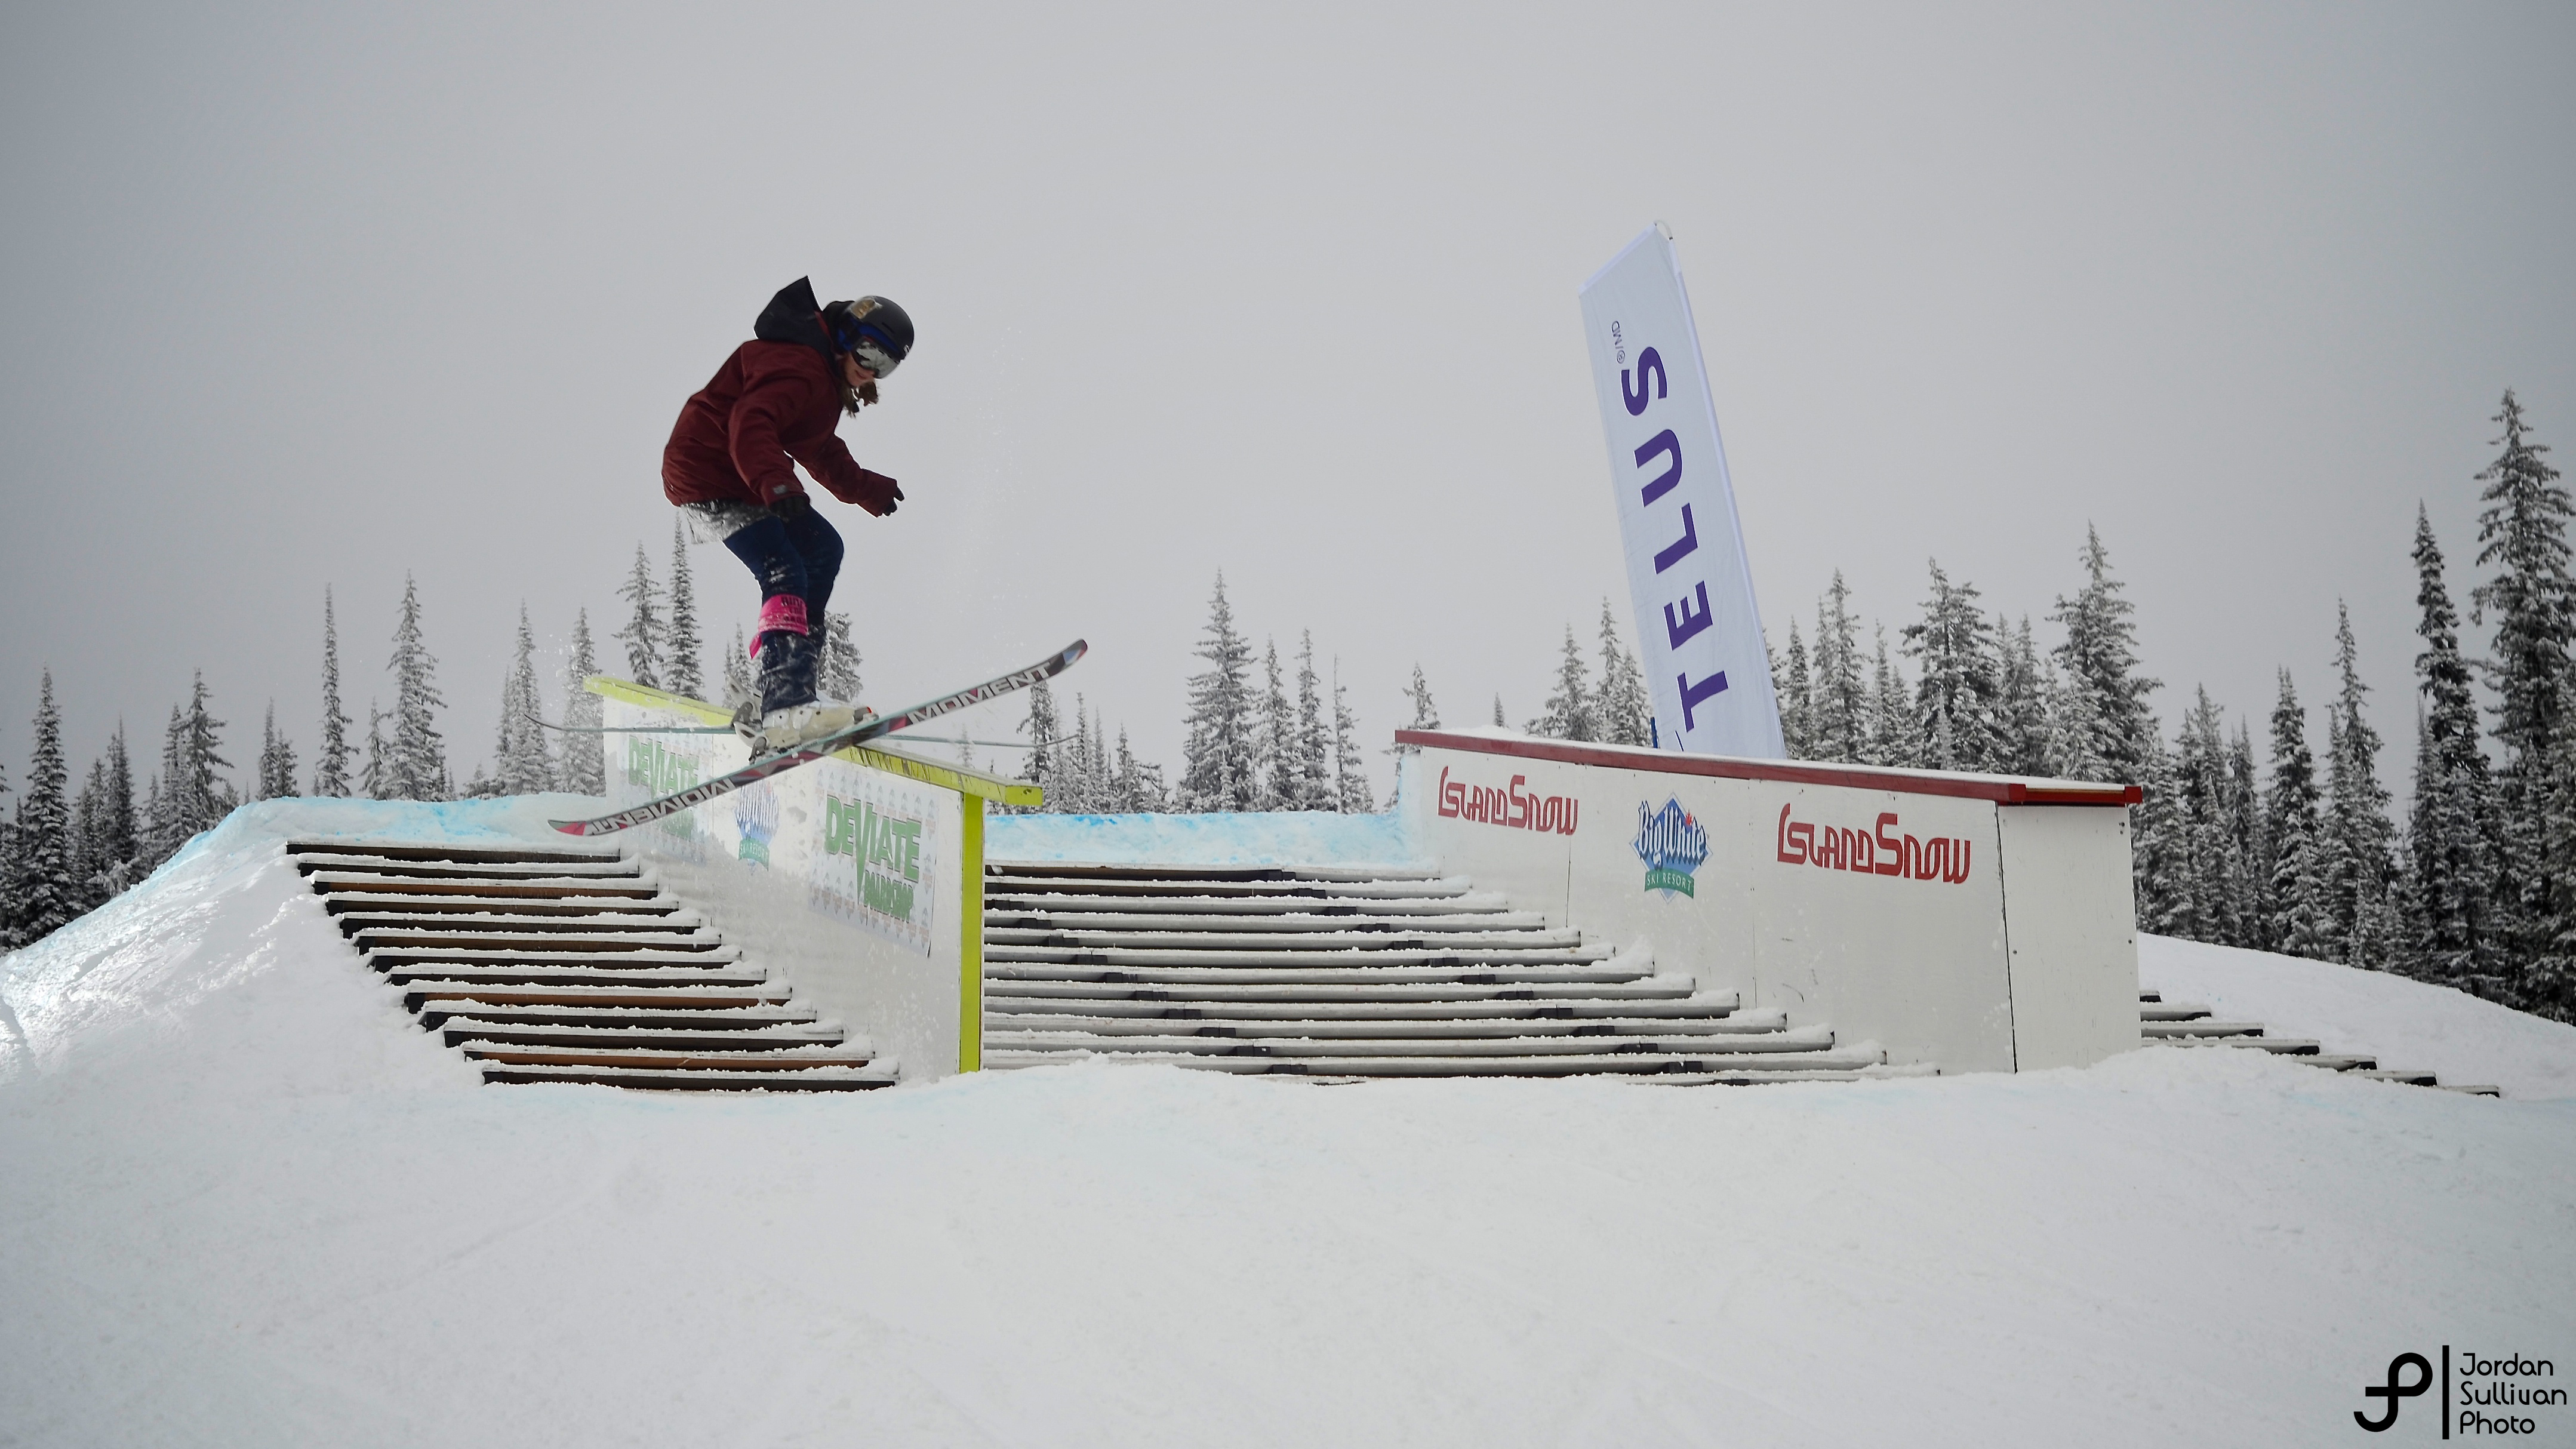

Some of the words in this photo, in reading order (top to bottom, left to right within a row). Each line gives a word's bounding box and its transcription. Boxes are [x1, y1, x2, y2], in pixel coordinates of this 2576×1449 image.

[1620, 346, 1729, 733] TELUS
[906, 661, 1051, 725] MOMENT
[584, 777, 737, 835] MOMENT
[824, 794, 922, 904] DEVIATE
[1646, 872, 1659, 886] SKI
[1662, 872, 1692, 891] RESORT
